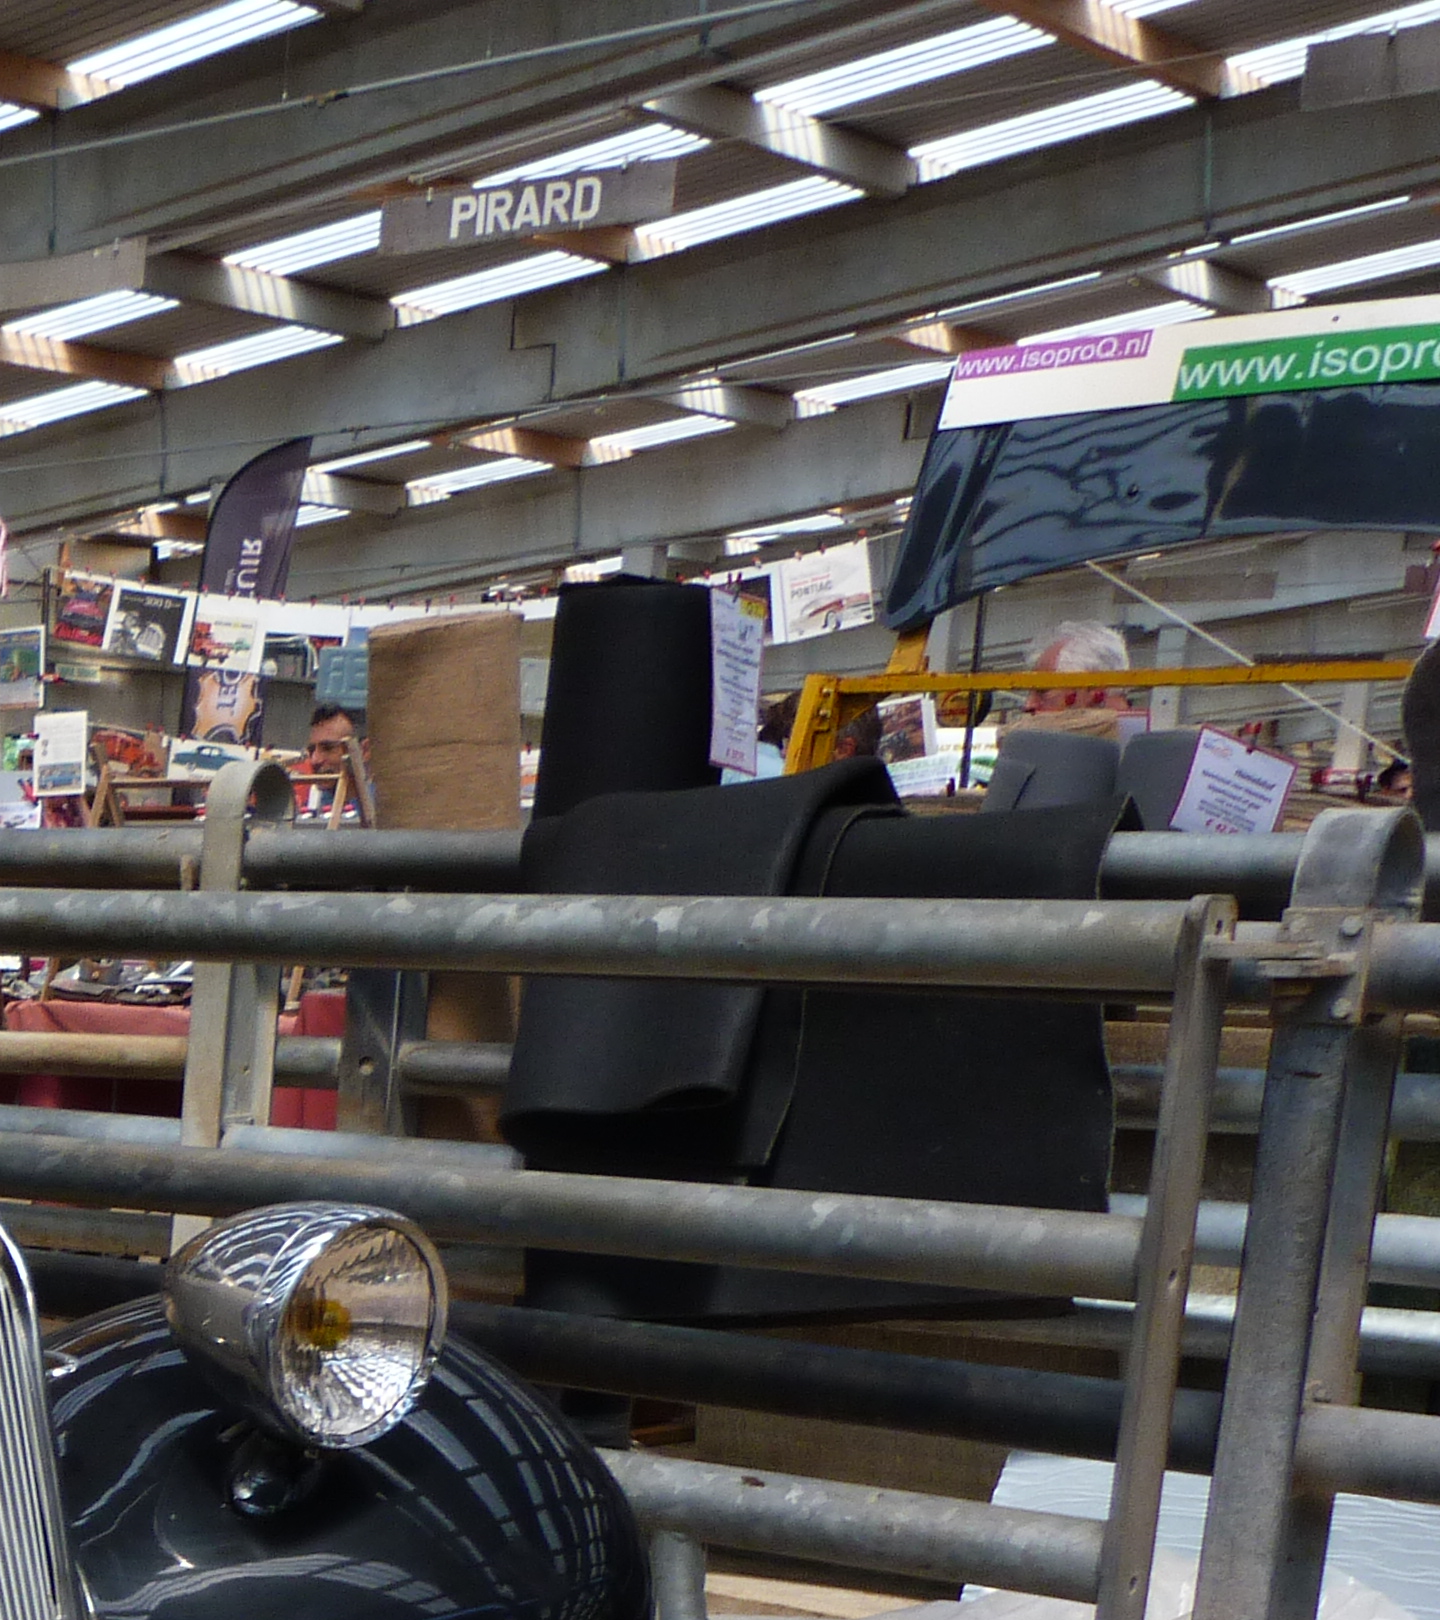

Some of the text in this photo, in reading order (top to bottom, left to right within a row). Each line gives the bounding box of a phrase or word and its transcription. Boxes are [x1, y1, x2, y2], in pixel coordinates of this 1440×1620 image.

[450, 177, 602, 239] PIRARD
[957, 332, 1150, 377] www.isoproQ.nl
[1180, 339, 1440, 391] www.isopr
